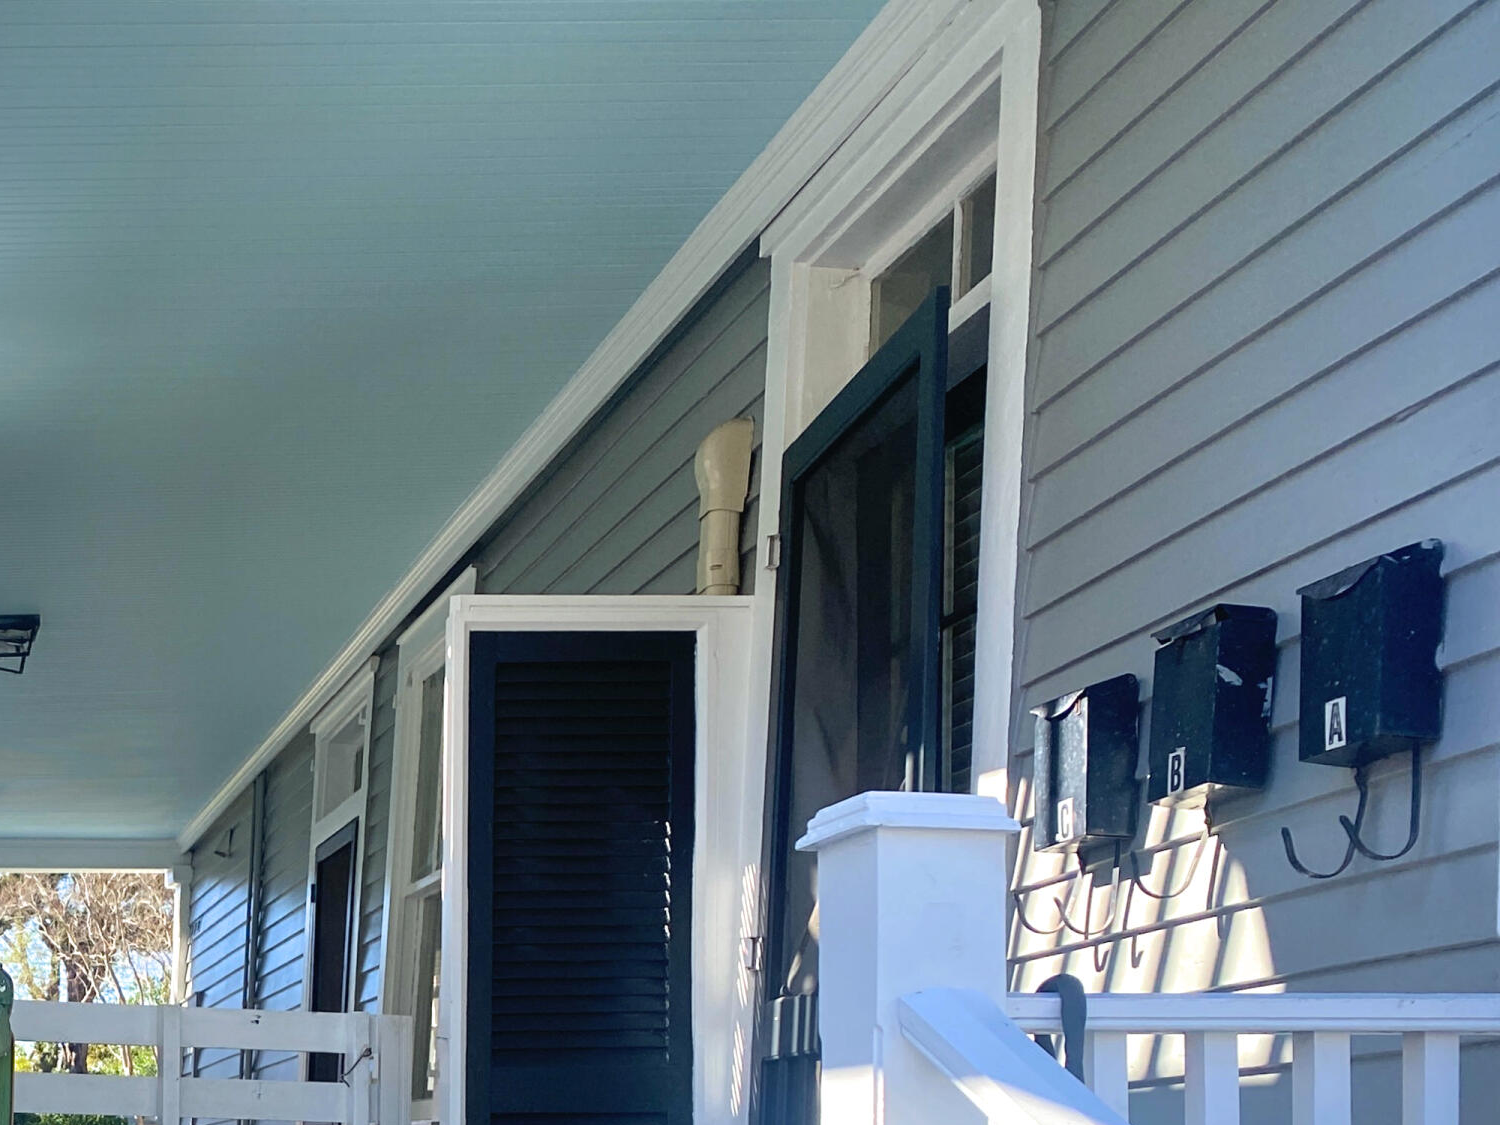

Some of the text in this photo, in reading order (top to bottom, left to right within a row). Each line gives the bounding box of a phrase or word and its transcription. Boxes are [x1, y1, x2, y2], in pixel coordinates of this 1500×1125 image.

[1328, 702, 1344, 746] A
[1170, 754, 1182, 793] B
[1060, 803, 1070, 839] C
